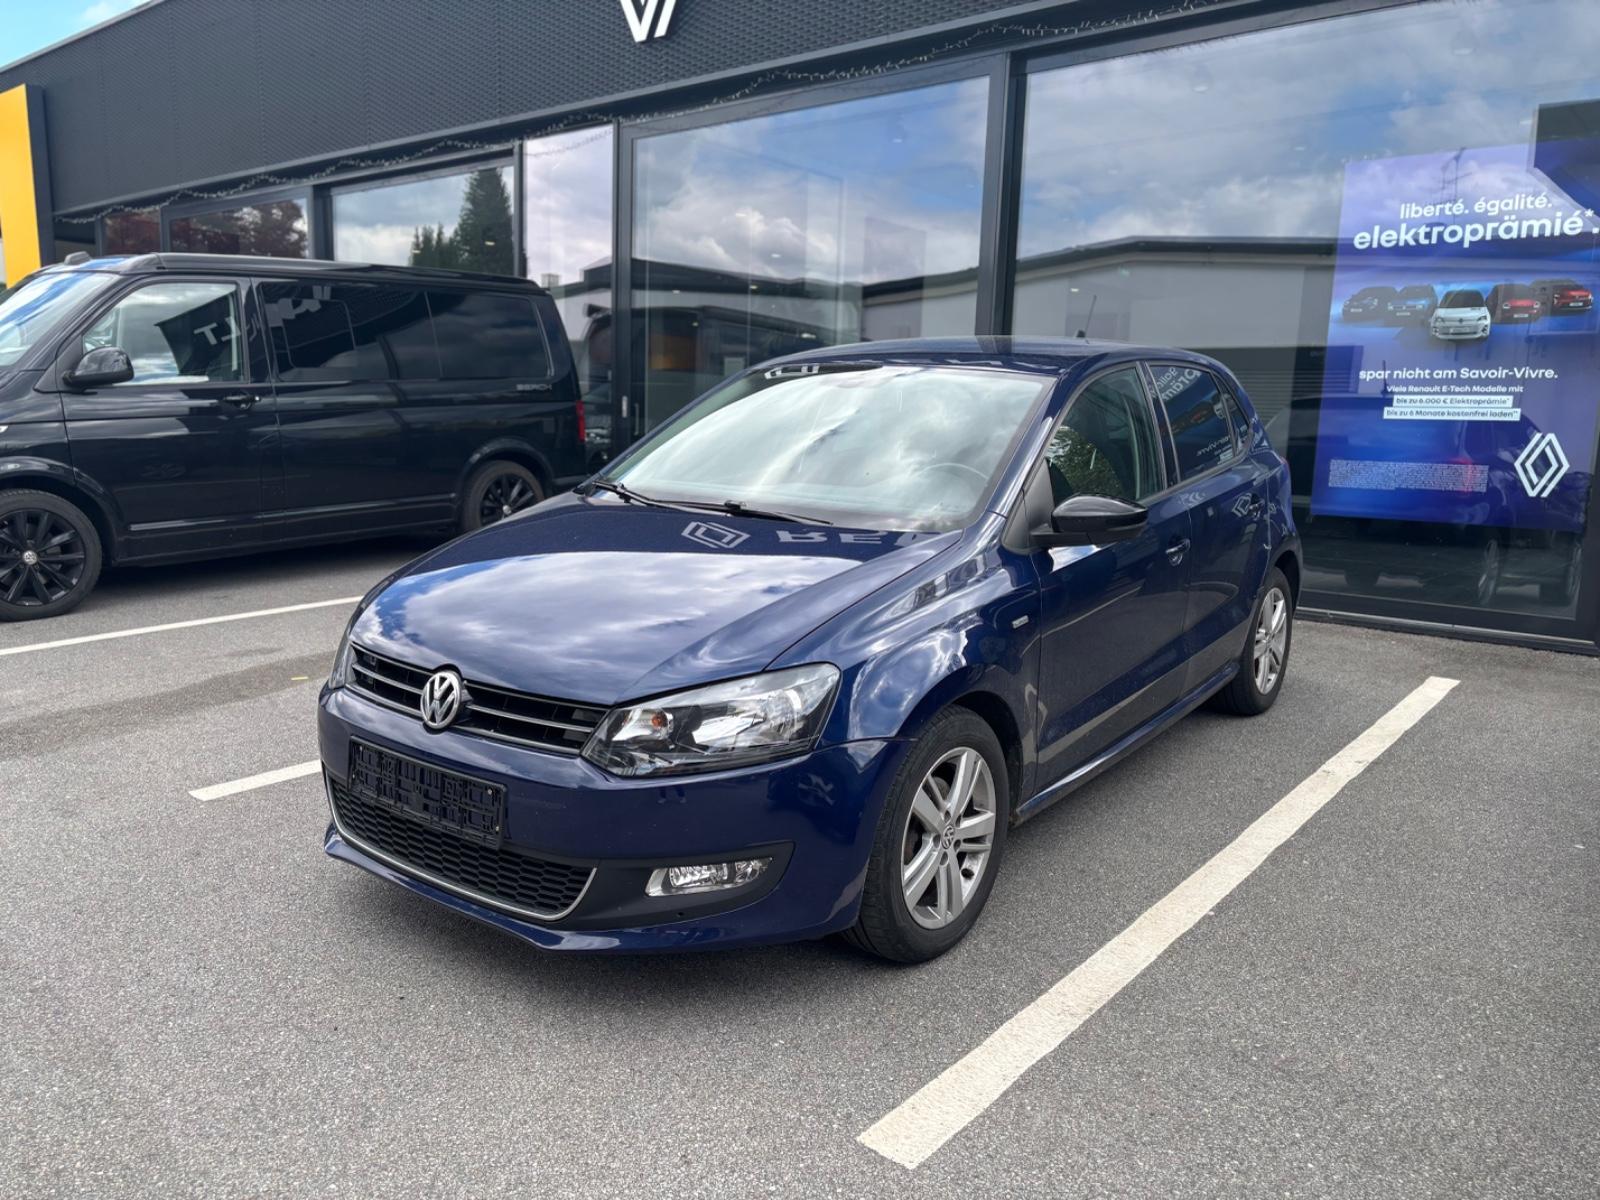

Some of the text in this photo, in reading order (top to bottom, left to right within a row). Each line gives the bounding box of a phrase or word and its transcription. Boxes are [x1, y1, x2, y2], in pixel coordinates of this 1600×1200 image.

[1400, 191, 1553, 219] liberté. égalité.
[1359, 366, 1558, 381] spar nicht am Savoir-Vivre.
[1386, 385, 1523, 393] Viele Renault E-Tech Modelle mit
